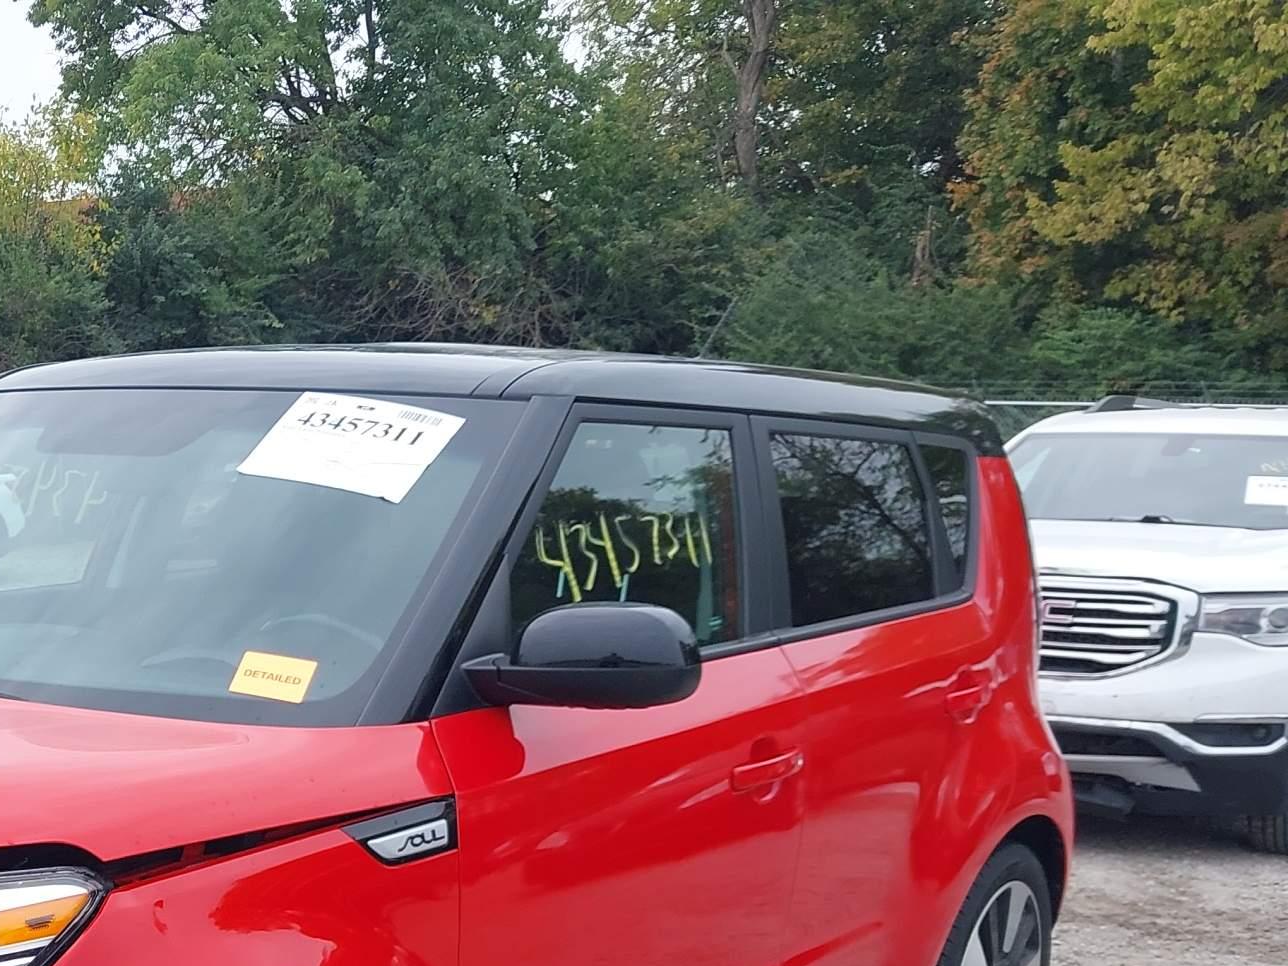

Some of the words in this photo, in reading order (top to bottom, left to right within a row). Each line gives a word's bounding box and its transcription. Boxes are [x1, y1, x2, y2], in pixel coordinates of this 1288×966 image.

[297, 411, 425, 446] 43457311
[535, 511, 712, 603] 43457311
[243, 668, 302, 686] DETAILED
